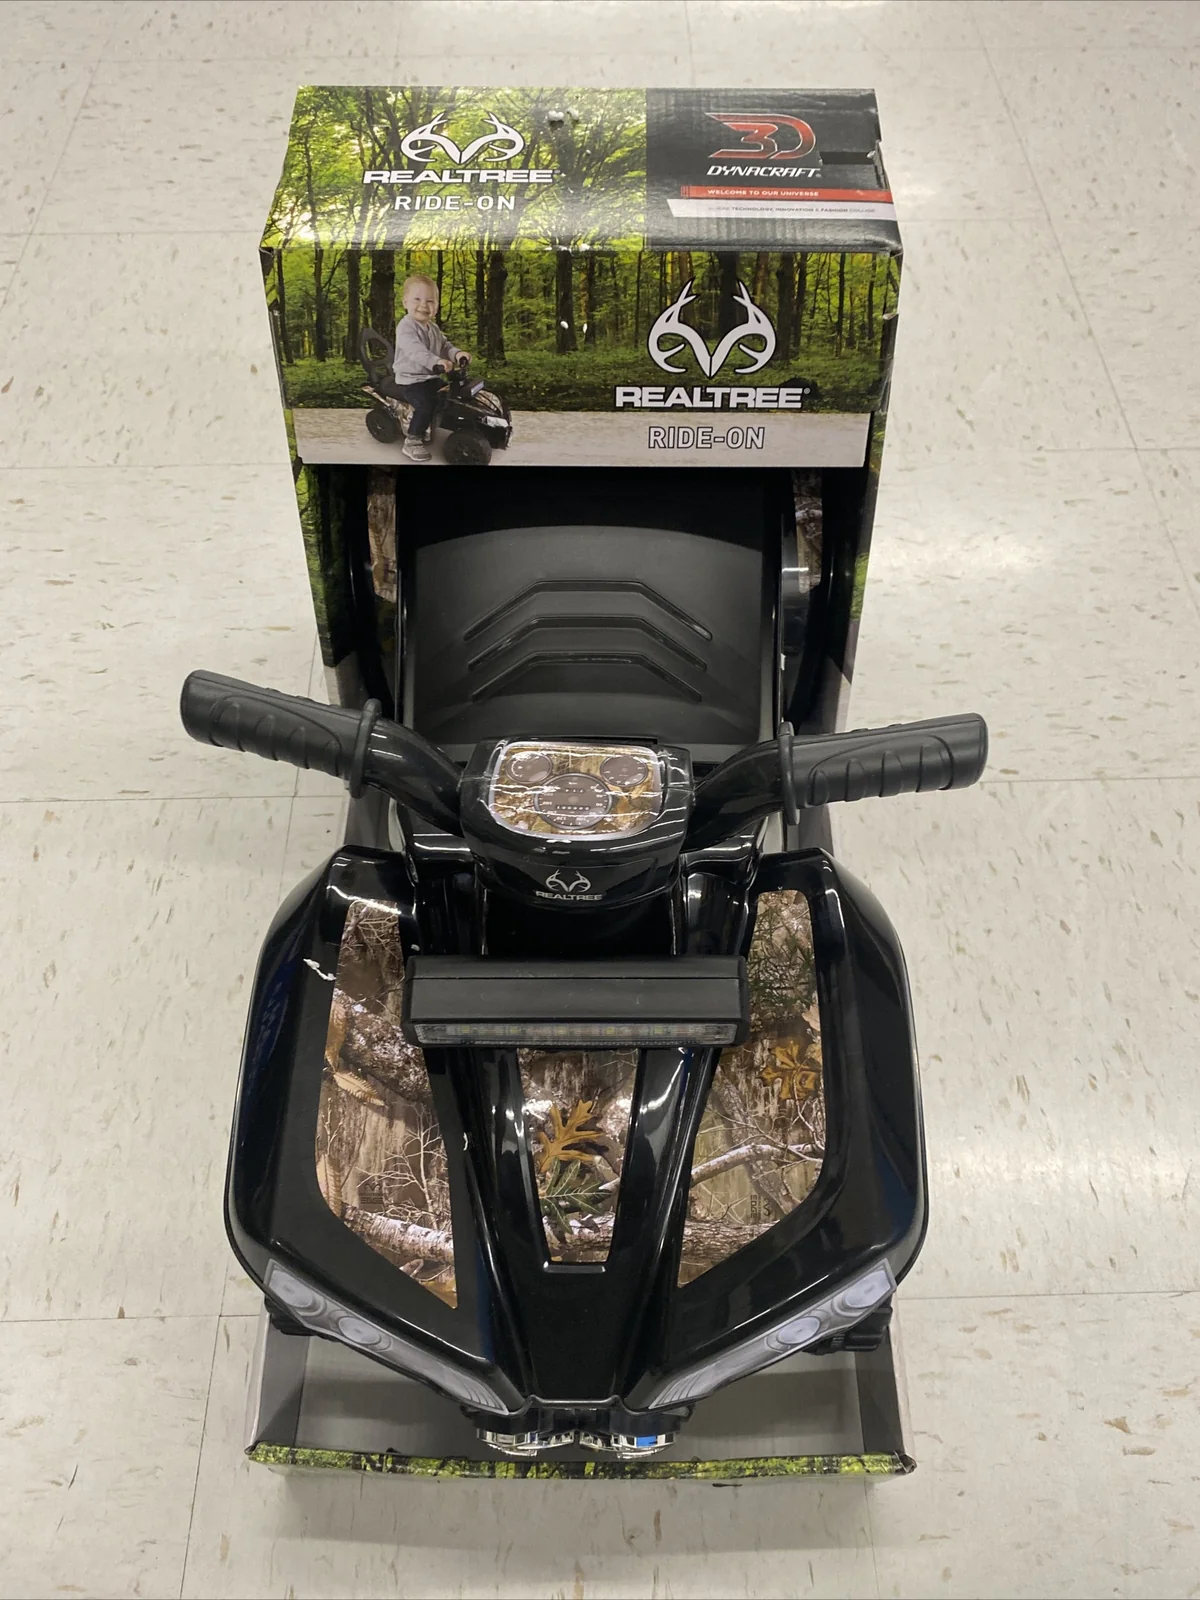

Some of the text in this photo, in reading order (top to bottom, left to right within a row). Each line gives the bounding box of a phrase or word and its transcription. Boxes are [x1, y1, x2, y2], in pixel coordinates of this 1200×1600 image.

[393, 195, 515, 211] RIDE-ON
[648, 425, 766, 449] RIDE-ON
[535, 890, 603, 901] REALTREE
